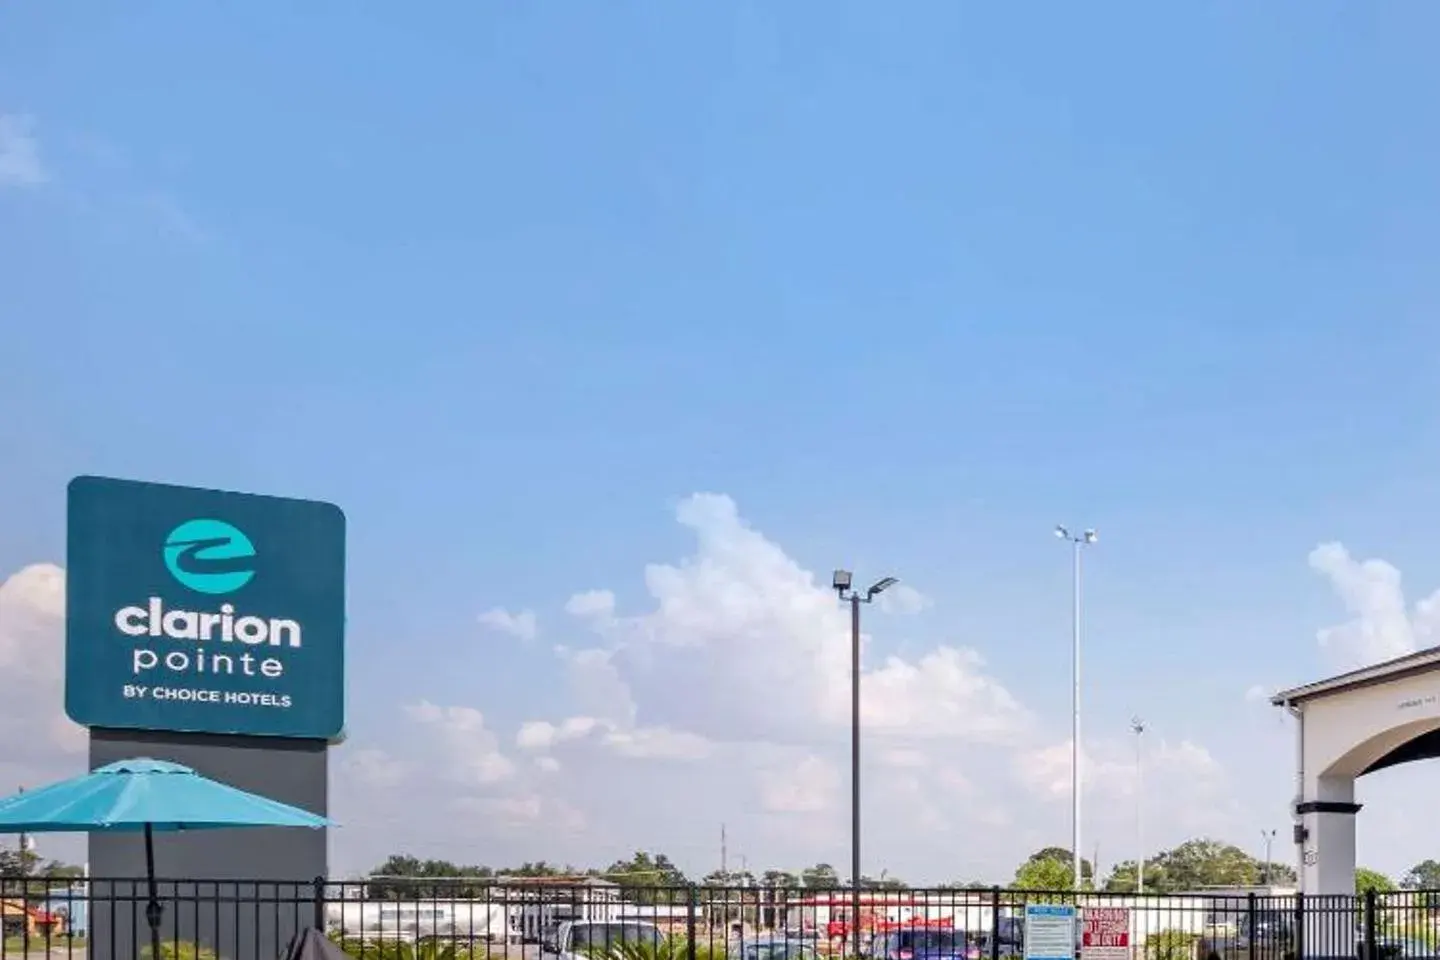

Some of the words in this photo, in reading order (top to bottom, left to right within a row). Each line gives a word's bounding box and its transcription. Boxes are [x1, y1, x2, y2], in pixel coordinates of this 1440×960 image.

[114, 596, 301, 648] clarion
[133, 648, 284, 677] pointe
[123, 685, 148, 698] BY
[153, 686, 220, 703] CHOICE
[224, 692, 292, 708] HOTELS
